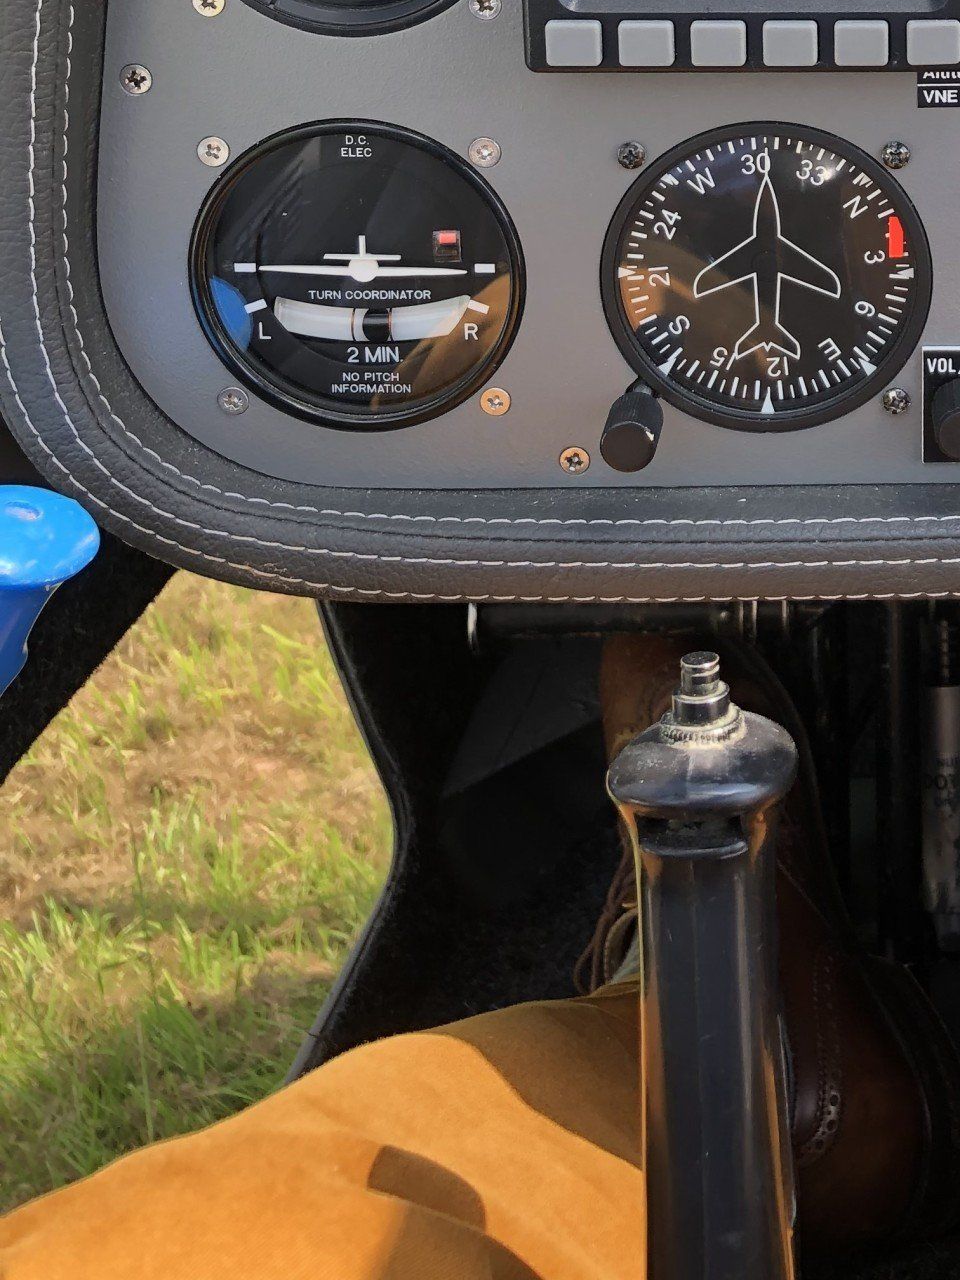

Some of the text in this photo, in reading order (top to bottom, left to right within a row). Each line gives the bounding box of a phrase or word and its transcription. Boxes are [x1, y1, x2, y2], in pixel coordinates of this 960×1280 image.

[923, 90, 958, 103] VNE
[344, 135, 369, 145] D.C.
[340, 148, 372, 158] ELEC
[741, 152, 770, 175] 30
[796, 159, 827, 186] 33
[687, 167, 715, 195] W
[843, 195, 869, 219] N
[653, 208, 682, 240] 24
[864, 250, 885, 265] 3
[648, 266, 671, 287] 21
[308, 290, 431, 300] TURN COORDINATOR
[854, 300, 876, 317] 6
[259, 322, 272, 340] L
[464, 323, 479, 341] R
[668, 315, 691, 335] S
[347, 347, 360, 363] 2
[817, 337, 842, 361] E
[709, 346, 737, 371] 15
[766, 356, 789, 378] 12
[342, 372, 400, 382] NO PITCH
[331, 383, 412, 394] INFORMATION
